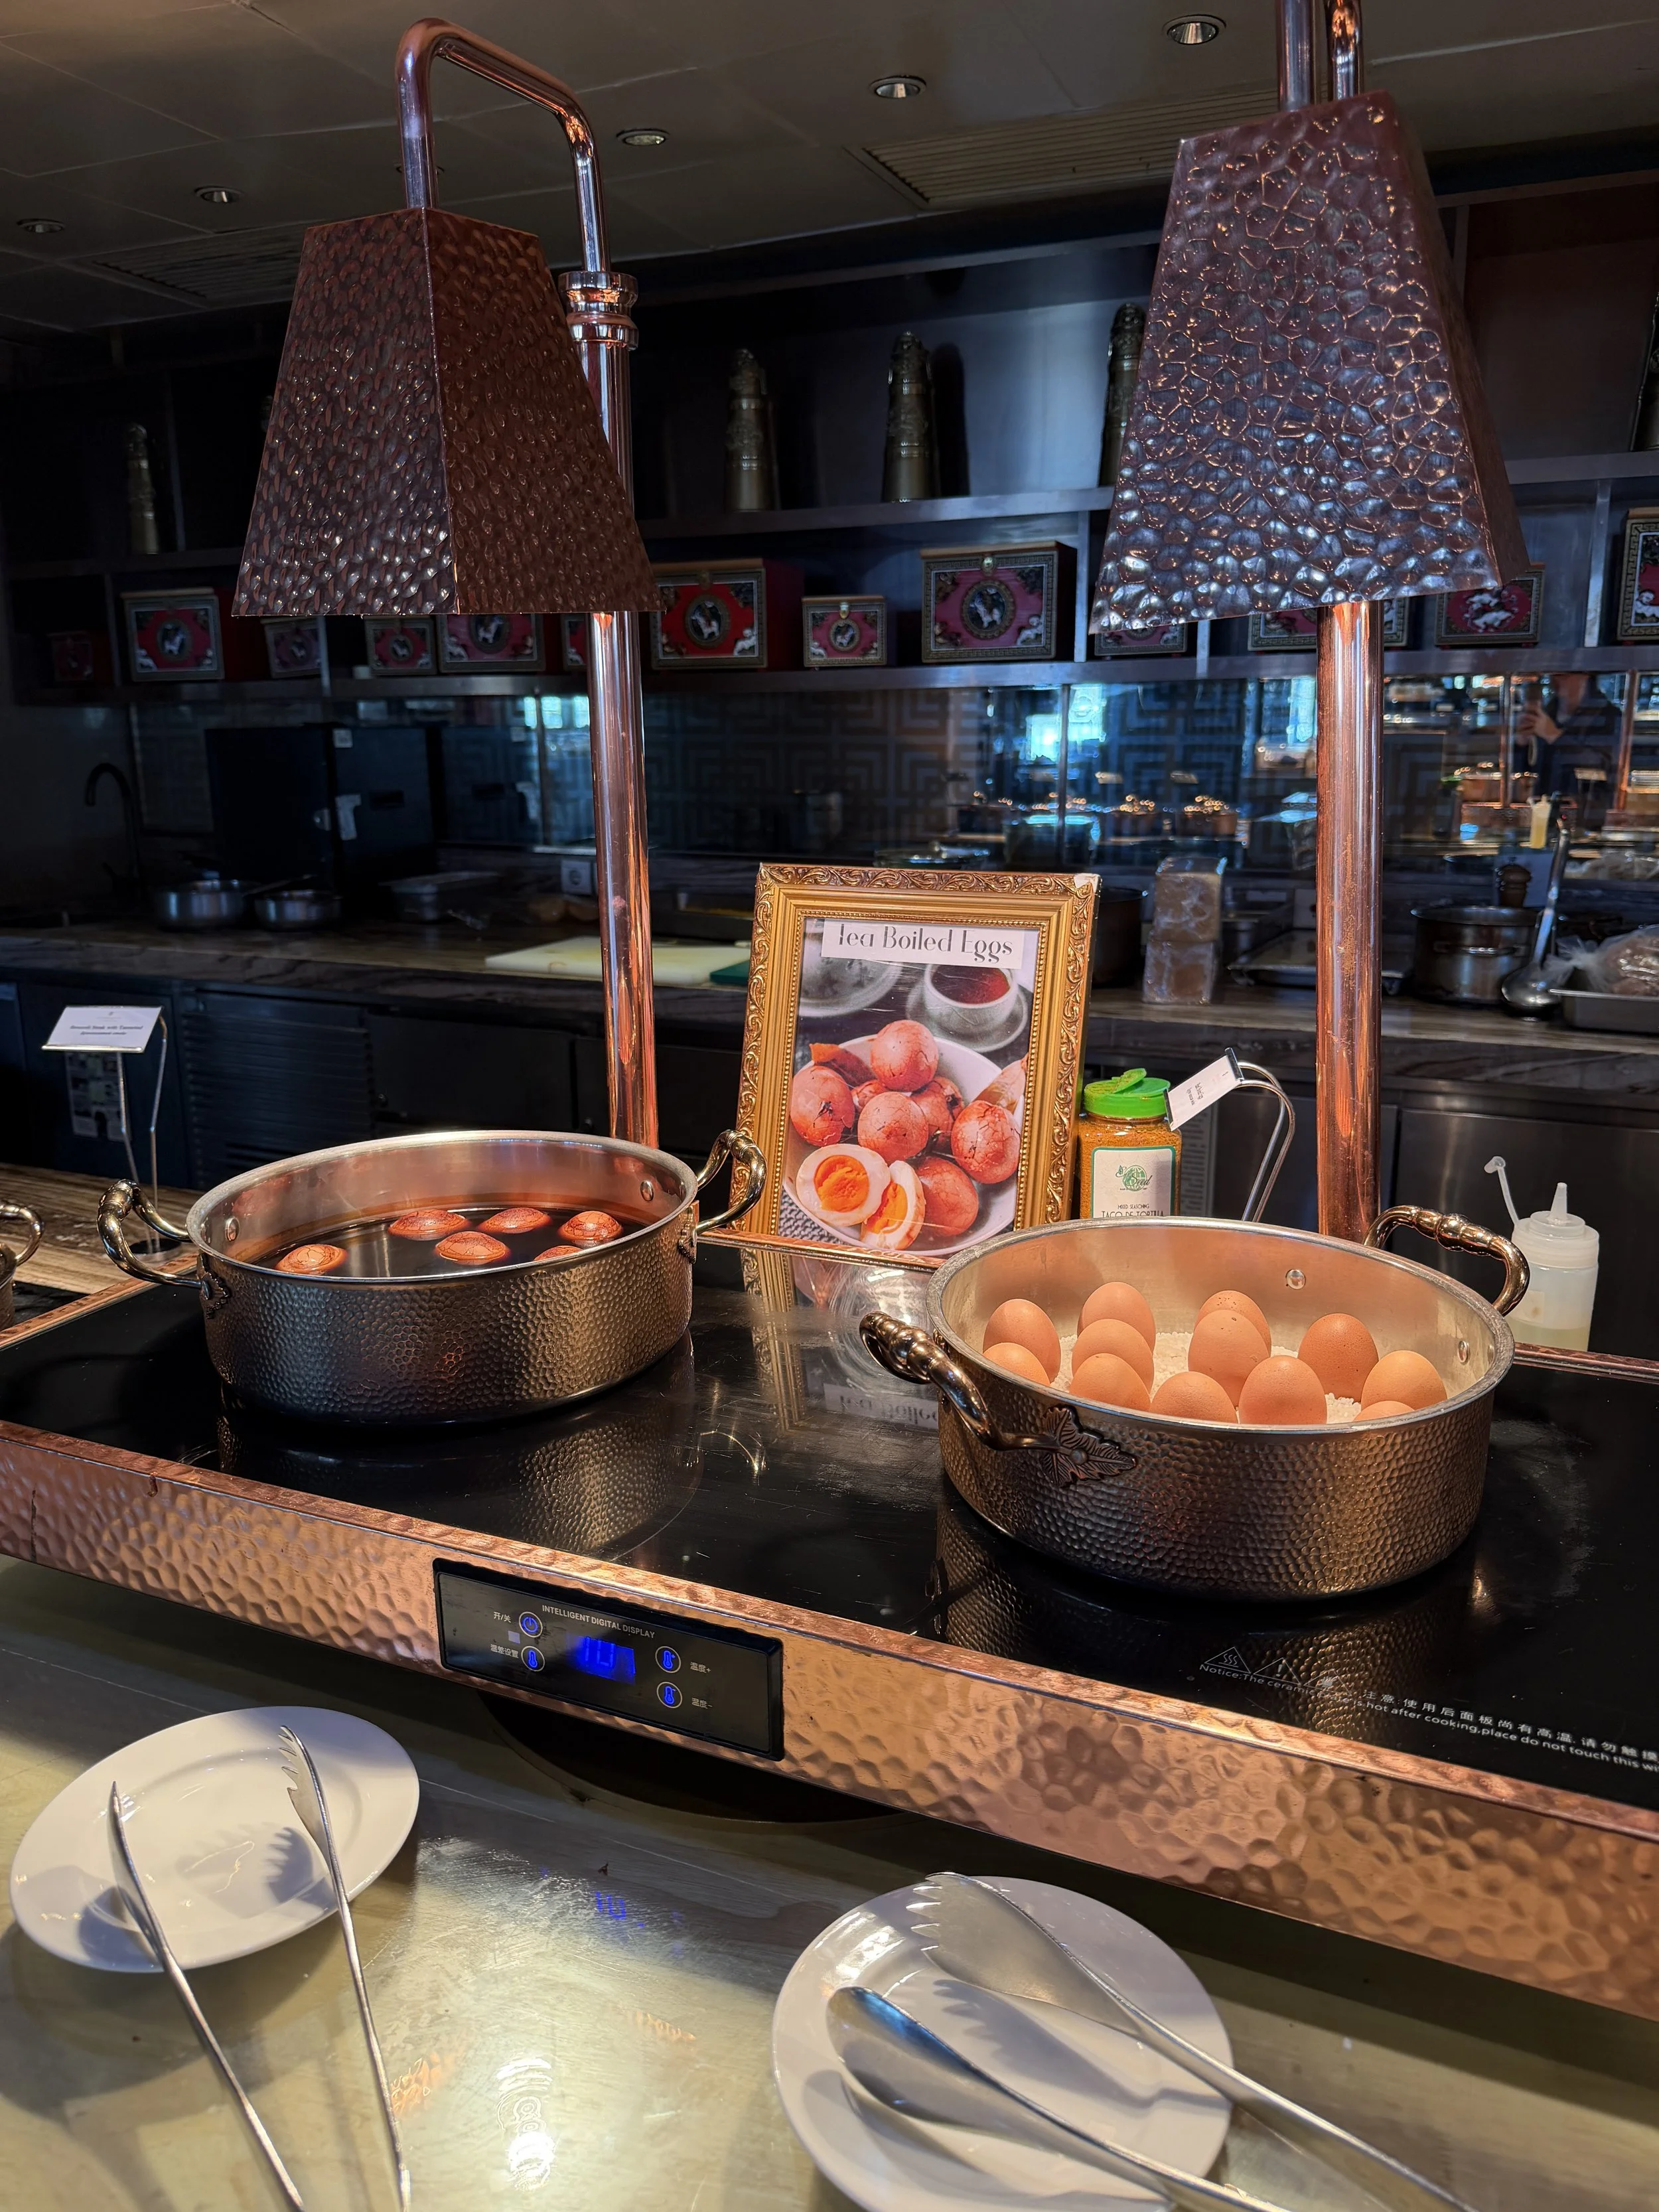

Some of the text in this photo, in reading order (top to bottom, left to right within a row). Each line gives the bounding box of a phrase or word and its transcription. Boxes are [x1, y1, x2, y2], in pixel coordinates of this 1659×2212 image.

[838, 923, 1013, 964] Tea Boiled Eggs
[493, 1611, 512, 1623] 开/关
[542, 1605, 656, 1639] INTELLIGENT DIGITAL DISPLAY
[1267, 1679, 1315, 1696] ceramic
[1366, 1700, 1388, 1713] hot
[1390, 1708, 1421, 1720] after
[1520, 1736, 1539, 1747] do
[1542, 1741, 1567, 1753] not
[1569, 1745, 1610, 1763] touch
[1613, 1755, 1640, 1769] this
